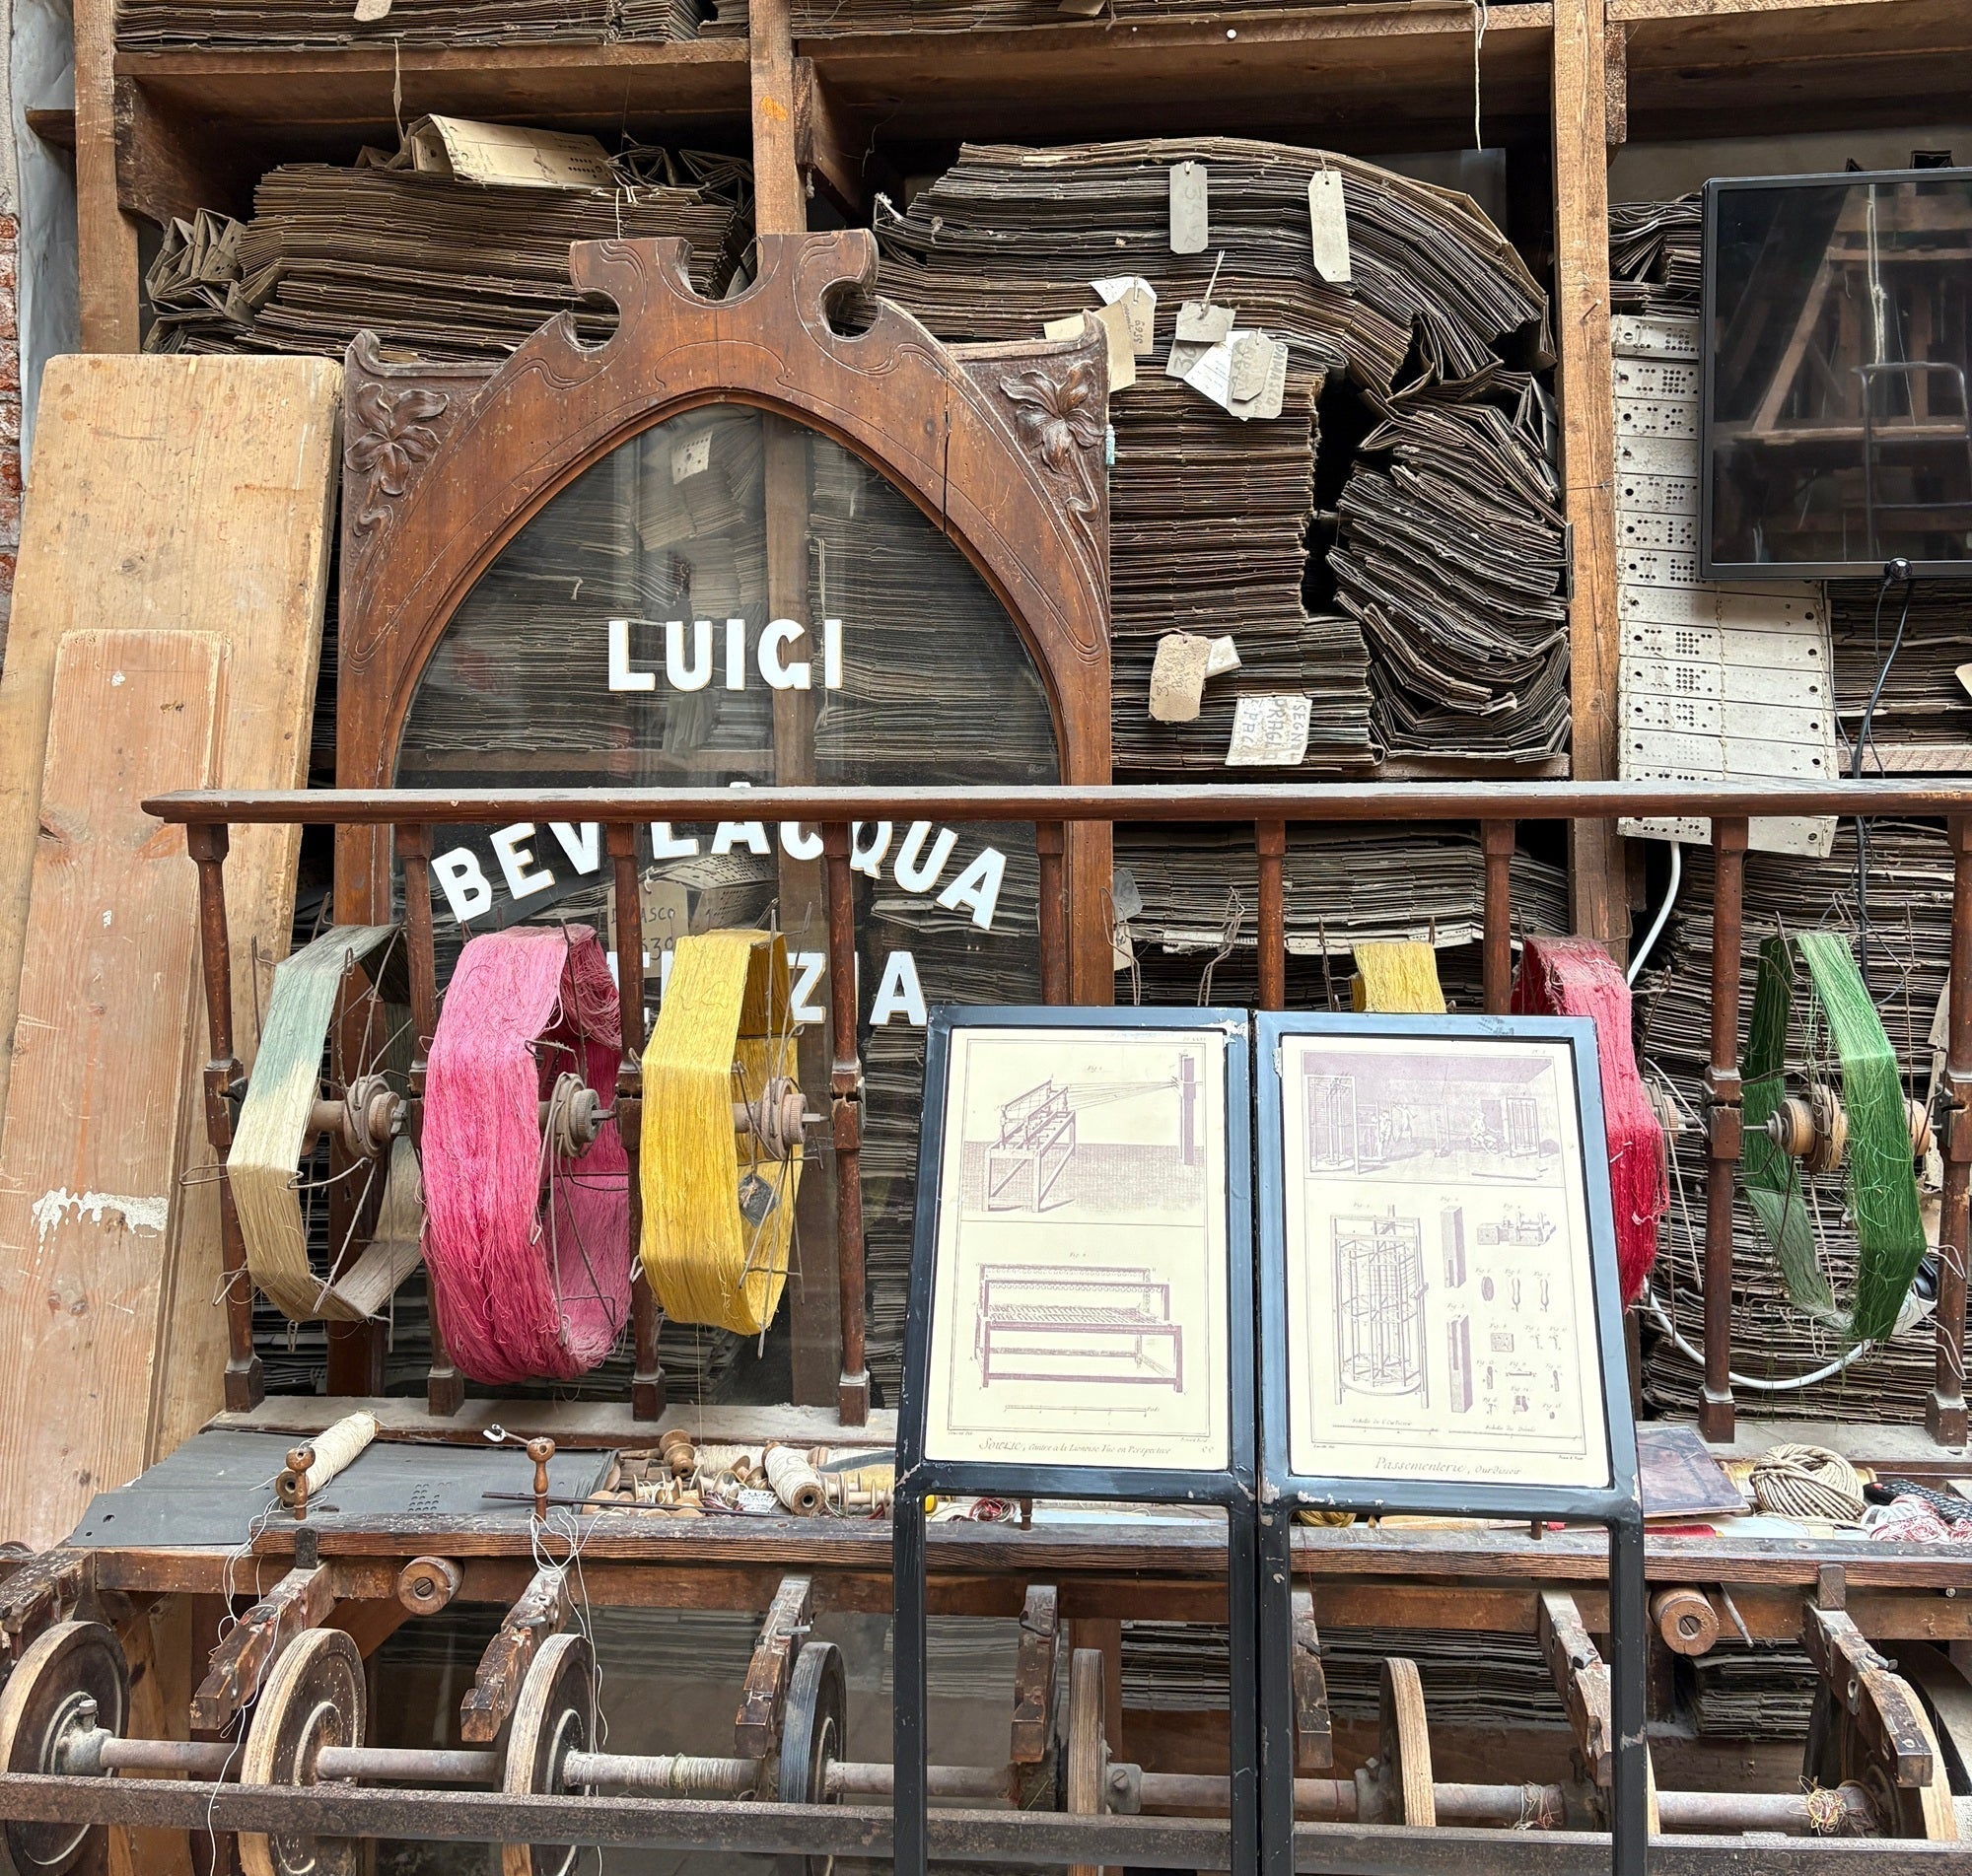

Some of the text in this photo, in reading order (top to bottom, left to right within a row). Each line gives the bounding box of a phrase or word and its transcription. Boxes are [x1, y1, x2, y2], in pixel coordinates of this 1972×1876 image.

[1266, 344, 1287, 406] DAMASCO
[608, 618, 843, 691] LUIGI
[432, 782, 1007, 931] BEVLACQUA
[1128, 1445, 1171, 1457] Perspective
